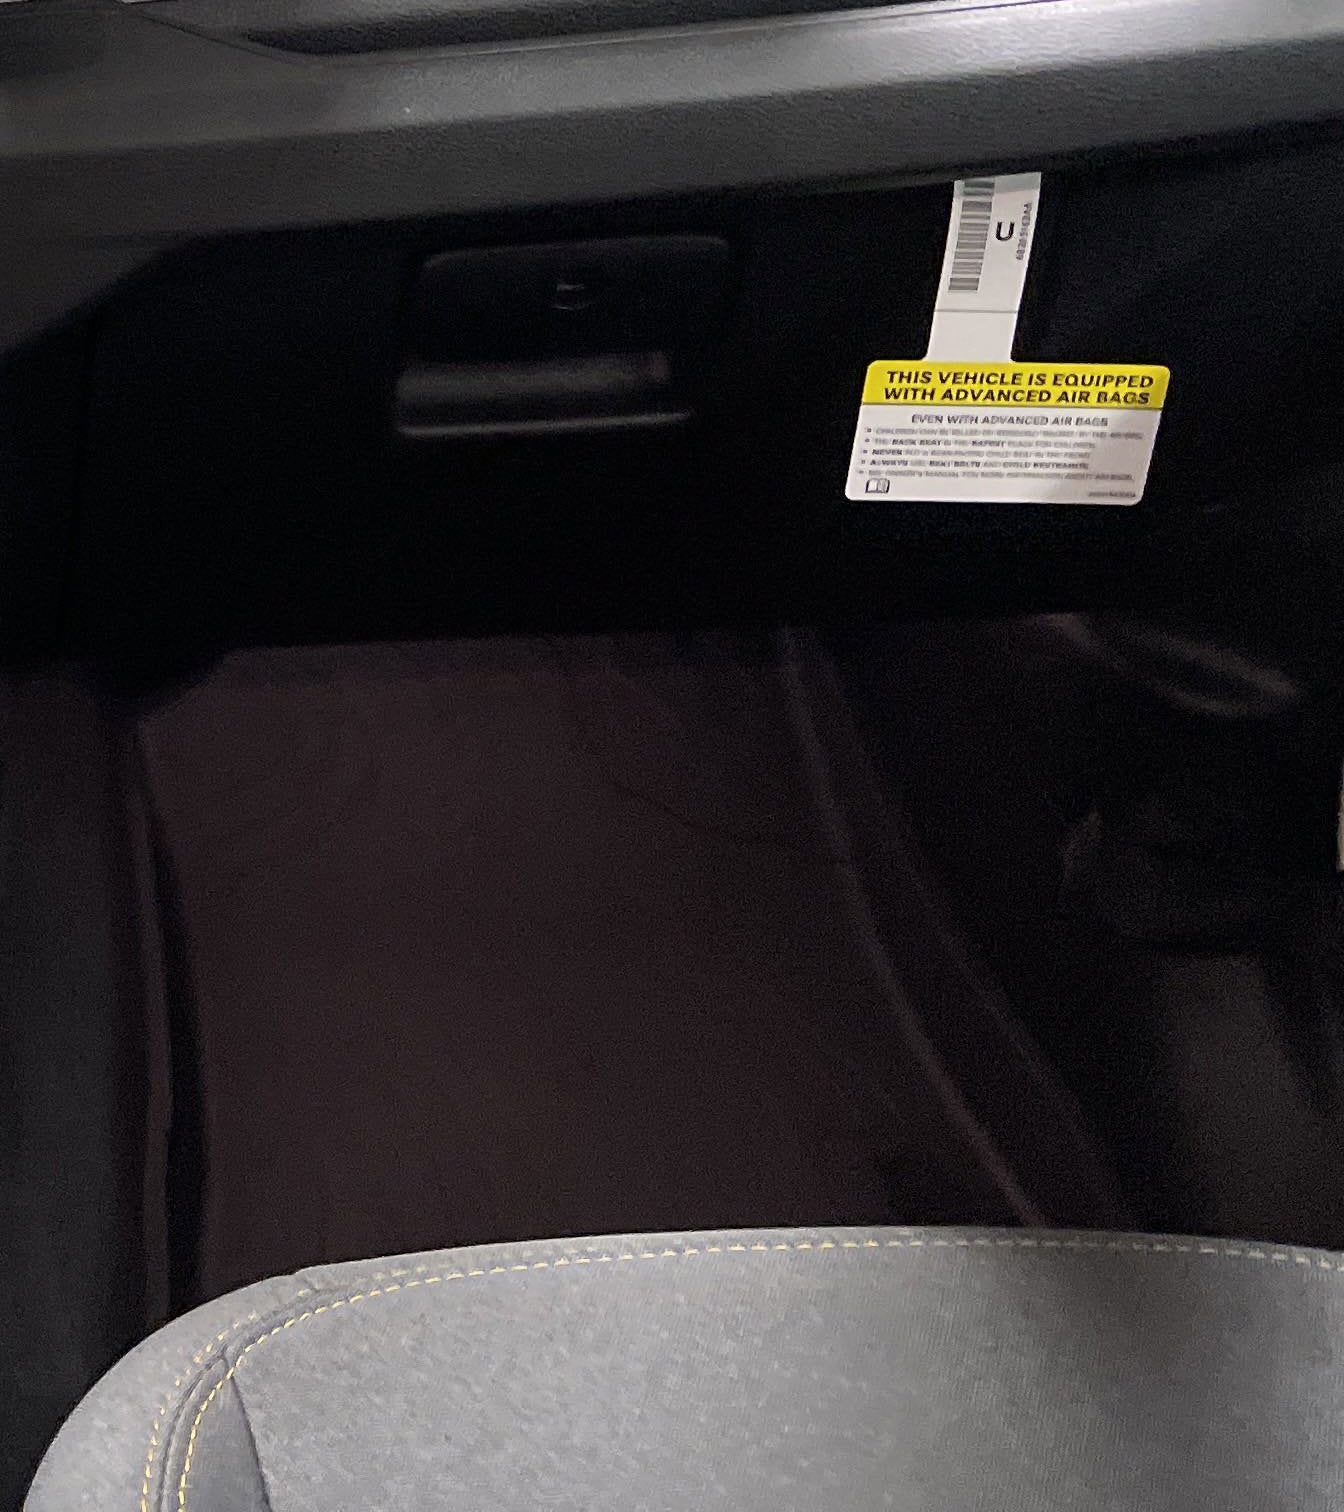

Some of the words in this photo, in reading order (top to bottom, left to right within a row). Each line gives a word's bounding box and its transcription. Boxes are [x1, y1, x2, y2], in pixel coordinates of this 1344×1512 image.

[995, 221, 1016, 242] U
[887, 370, 932, 385] THIS
[938, 371, 1022, 387] VEHICLE
[1028, 372, 1047, 387] IS
[1052, 373, 1154, 389] EQUIPPED
[883, 387, 936, 402] WITH
[940, 388, 1052, 404] ADVANCED
[1057, 389, 1091, 404] AIR
[1096, 391, 1151, 405] BAGS
[912, 414, 944, 424] EVEN
[947, 414, 978, 425] WITH
[981, 415, 1049, 426] ADVANCED
[1052, 416, 1072, 426] AIR
[1075, 417, 1109, 427] BAGS
